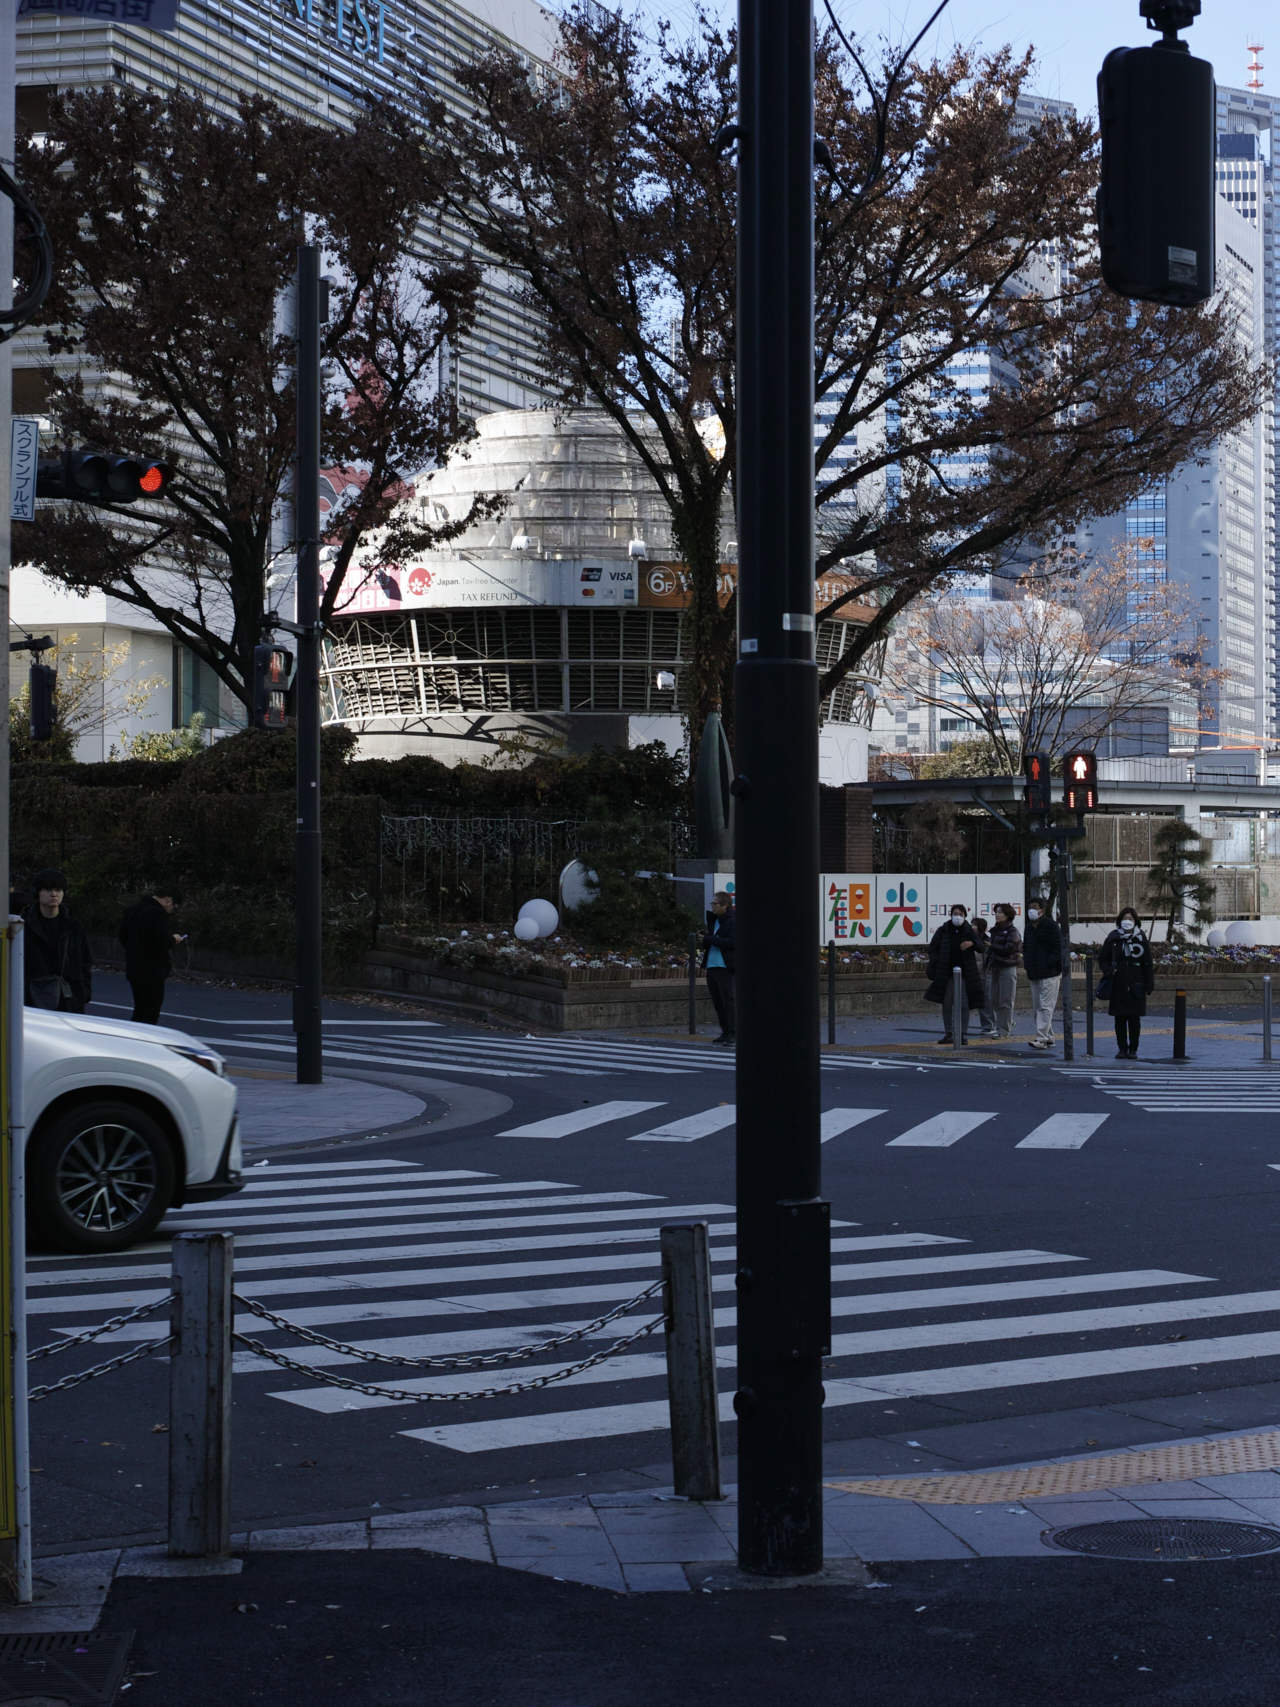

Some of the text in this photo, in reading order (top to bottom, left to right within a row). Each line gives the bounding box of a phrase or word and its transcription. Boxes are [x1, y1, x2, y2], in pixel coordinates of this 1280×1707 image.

[13, 423, 32, 517] スクランブル式
[437, 576, 518, 586] Japan. Tax-free Counter
[609, 571, 633, 581] VISA
[650, 572, 673, 593] 6F
[461, 592, 518, 602] TAX REFUND
